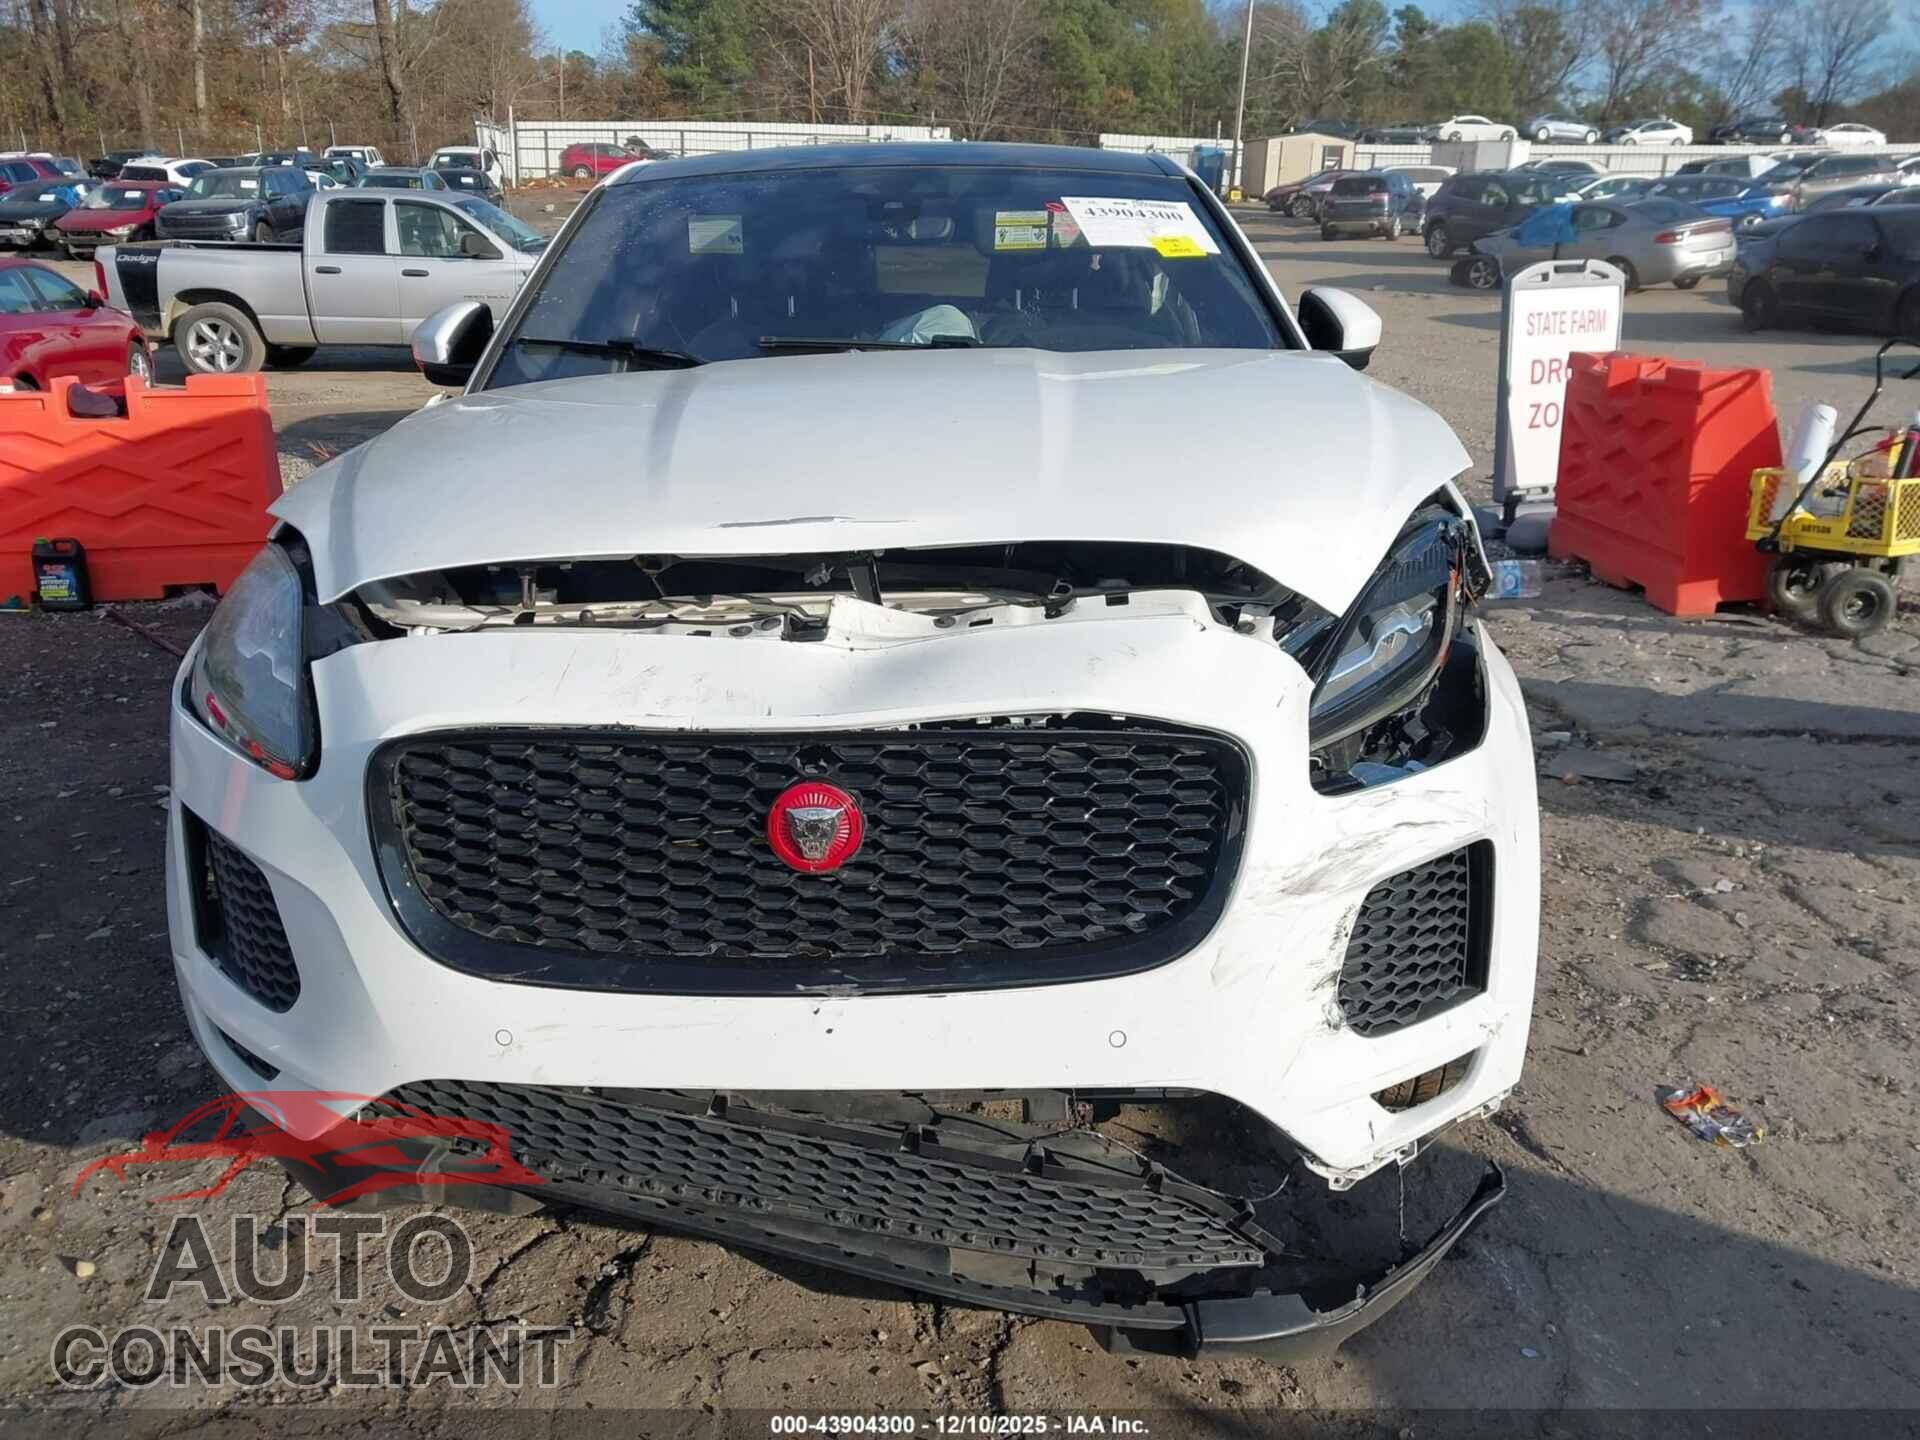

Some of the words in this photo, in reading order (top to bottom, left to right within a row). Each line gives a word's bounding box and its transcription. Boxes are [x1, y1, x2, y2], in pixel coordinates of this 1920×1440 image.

[1084, 206, 1184, 222] 43904300
[117, 254, 158, 264] Dodge
[1526, 311, 1567, 336] STATE
[1570, 308, 1607, 334] FARM
[1530, 358, 1574, 385] DR
[1528, 402, 1560, 429] ZO
